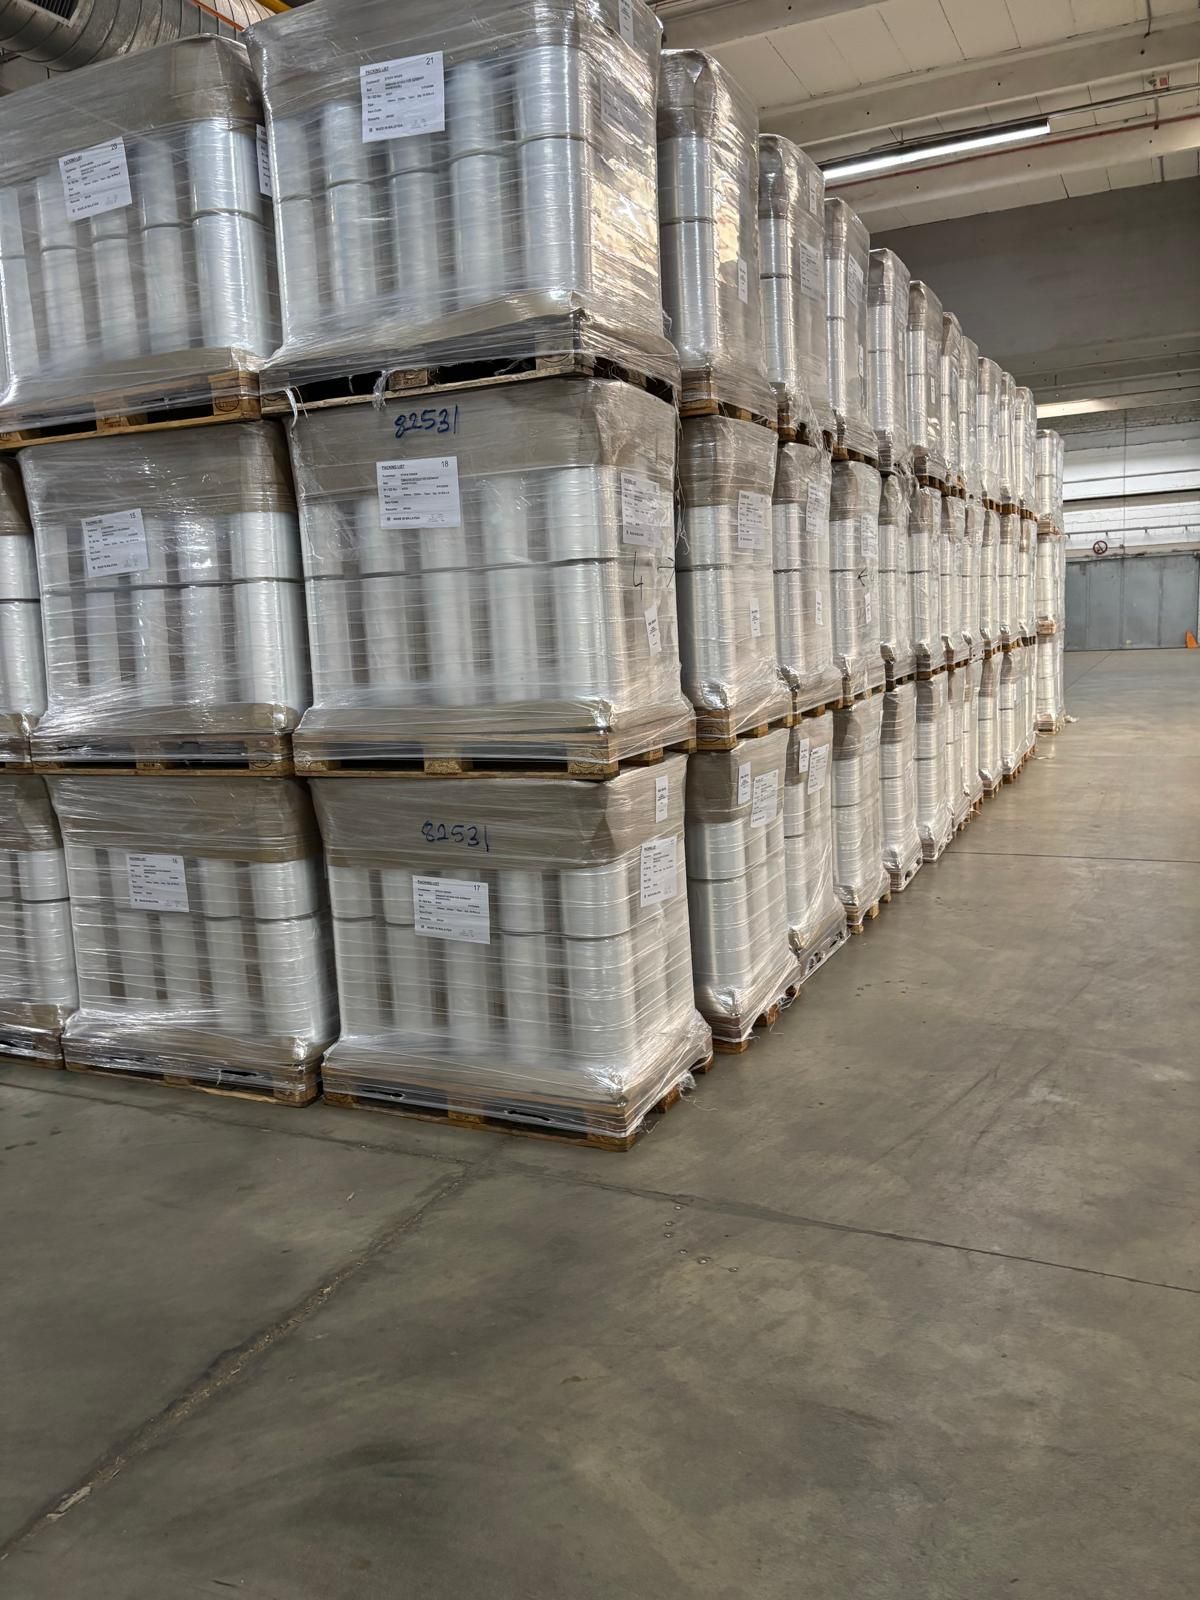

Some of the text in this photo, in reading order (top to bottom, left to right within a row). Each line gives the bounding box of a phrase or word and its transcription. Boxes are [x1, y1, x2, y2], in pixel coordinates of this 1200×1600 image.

[425, 57, 434, 65] 21
[395, 404, 458, 438] 82531
[421, 820, 489, 852] 82531
